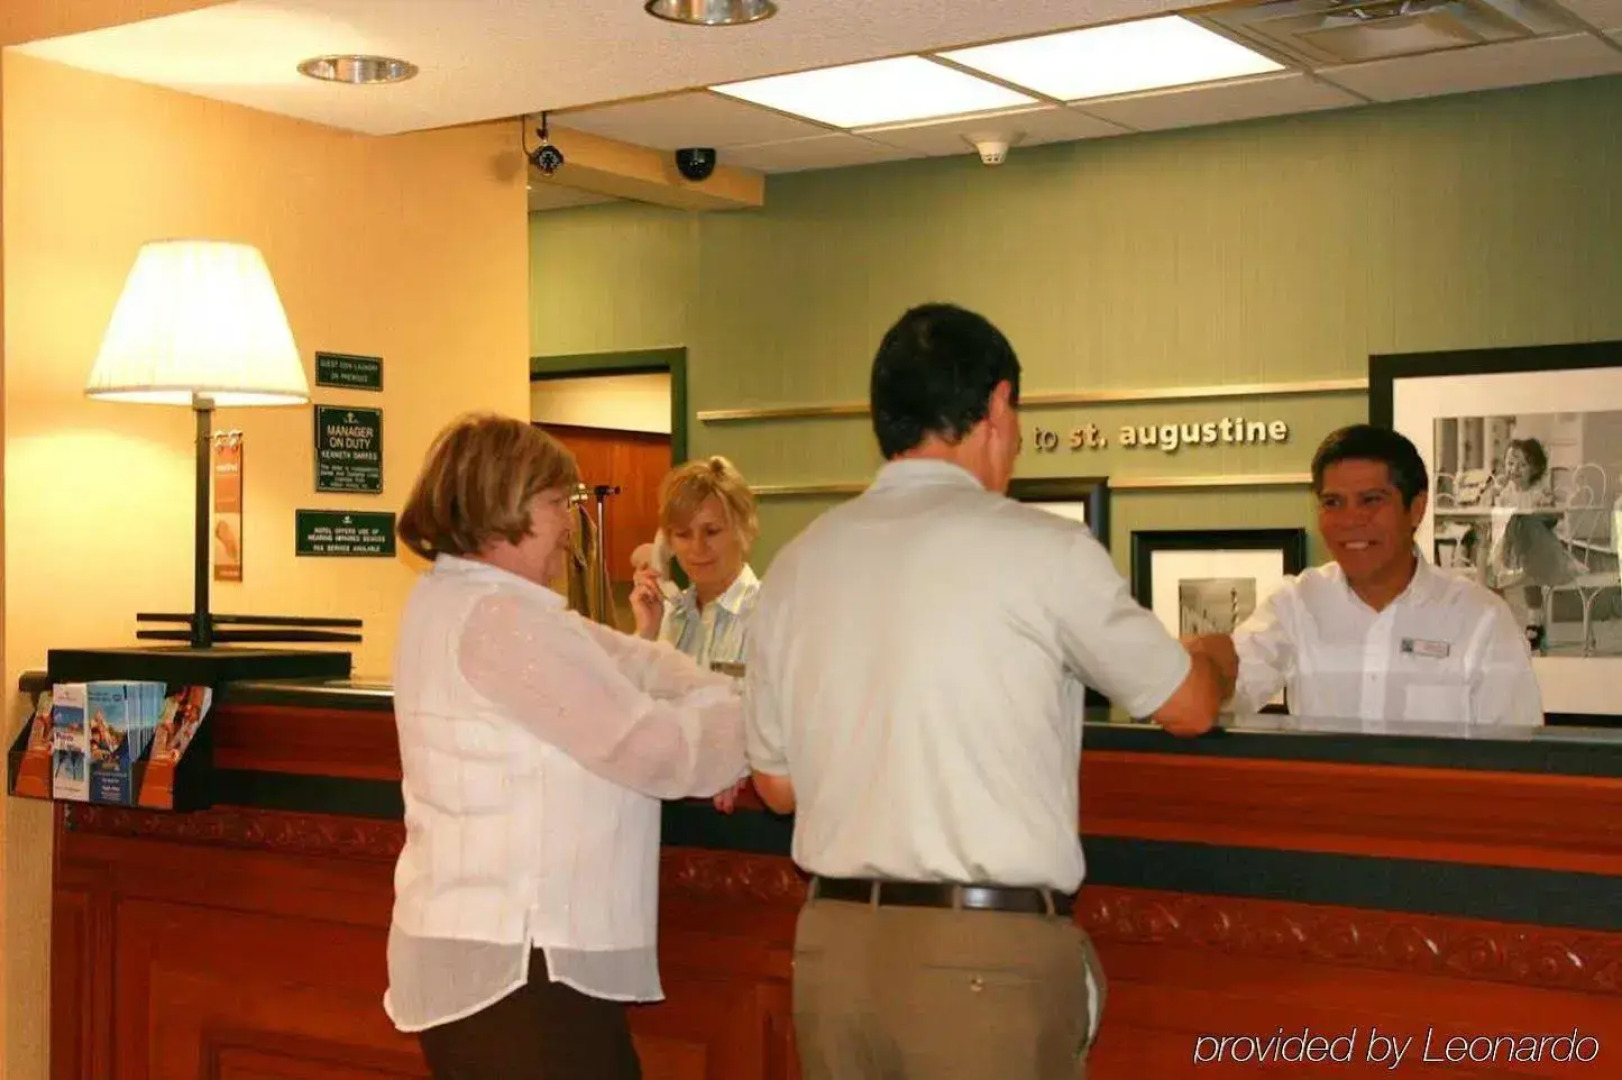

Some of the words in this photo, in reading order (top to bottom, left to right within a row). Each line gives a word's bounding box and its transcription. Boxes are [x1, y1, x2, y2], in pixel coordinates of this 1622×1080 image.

[327, 424, 373, 438] MANAGER
[1034, 427, 1056, 449] to
[1070, 423, 1107, 448] st.
[1120, 417, 1287, 451] augustine
[329, 437, 343, 448] ON
[346, 438, 371, 449] DUTY
